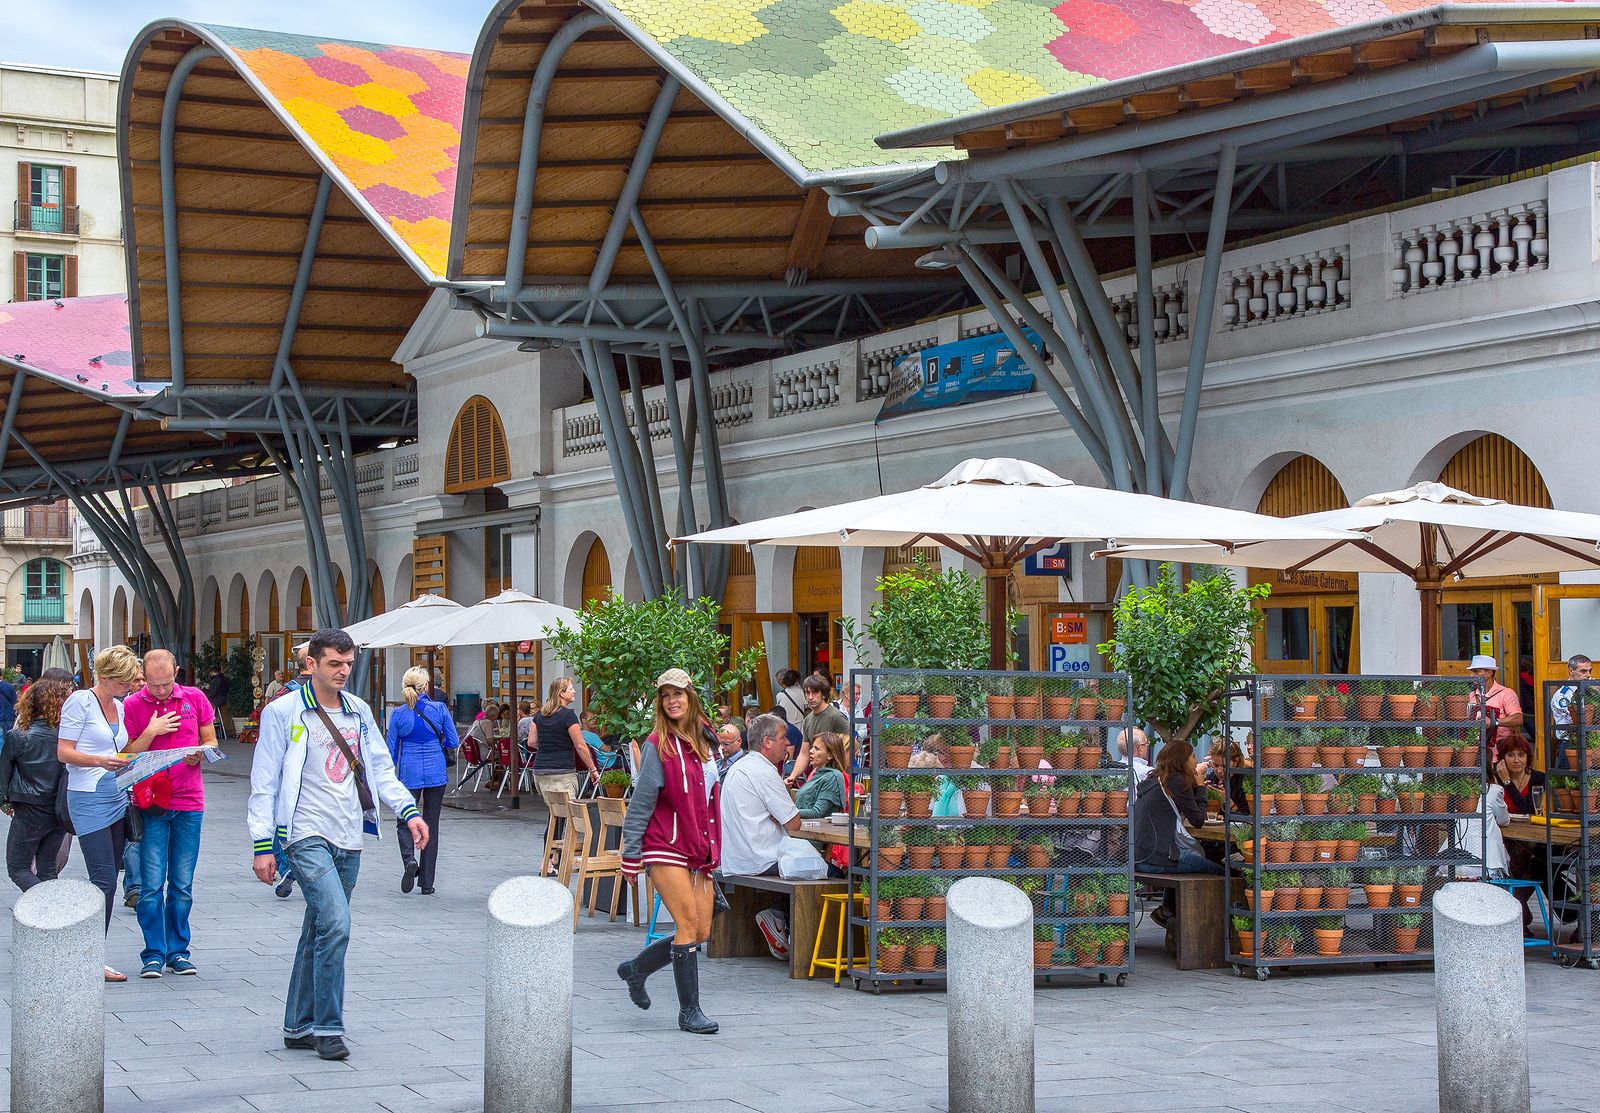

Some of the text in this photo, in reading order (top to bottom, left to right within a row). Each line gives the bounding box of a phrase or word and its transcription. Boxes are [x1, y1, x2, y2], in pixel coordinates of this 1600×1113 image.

[929, 362, 936, 382] P
[889, 375, 922, 402] mercat
[1037, 543, 1061, 569] P
[1300, 572, 1318, 588] Santa
[1320, 573, 1349, 592] Caterina
[1056, 622, 1083, 633] B:SM
[1052, 646, 1066, 672] P
